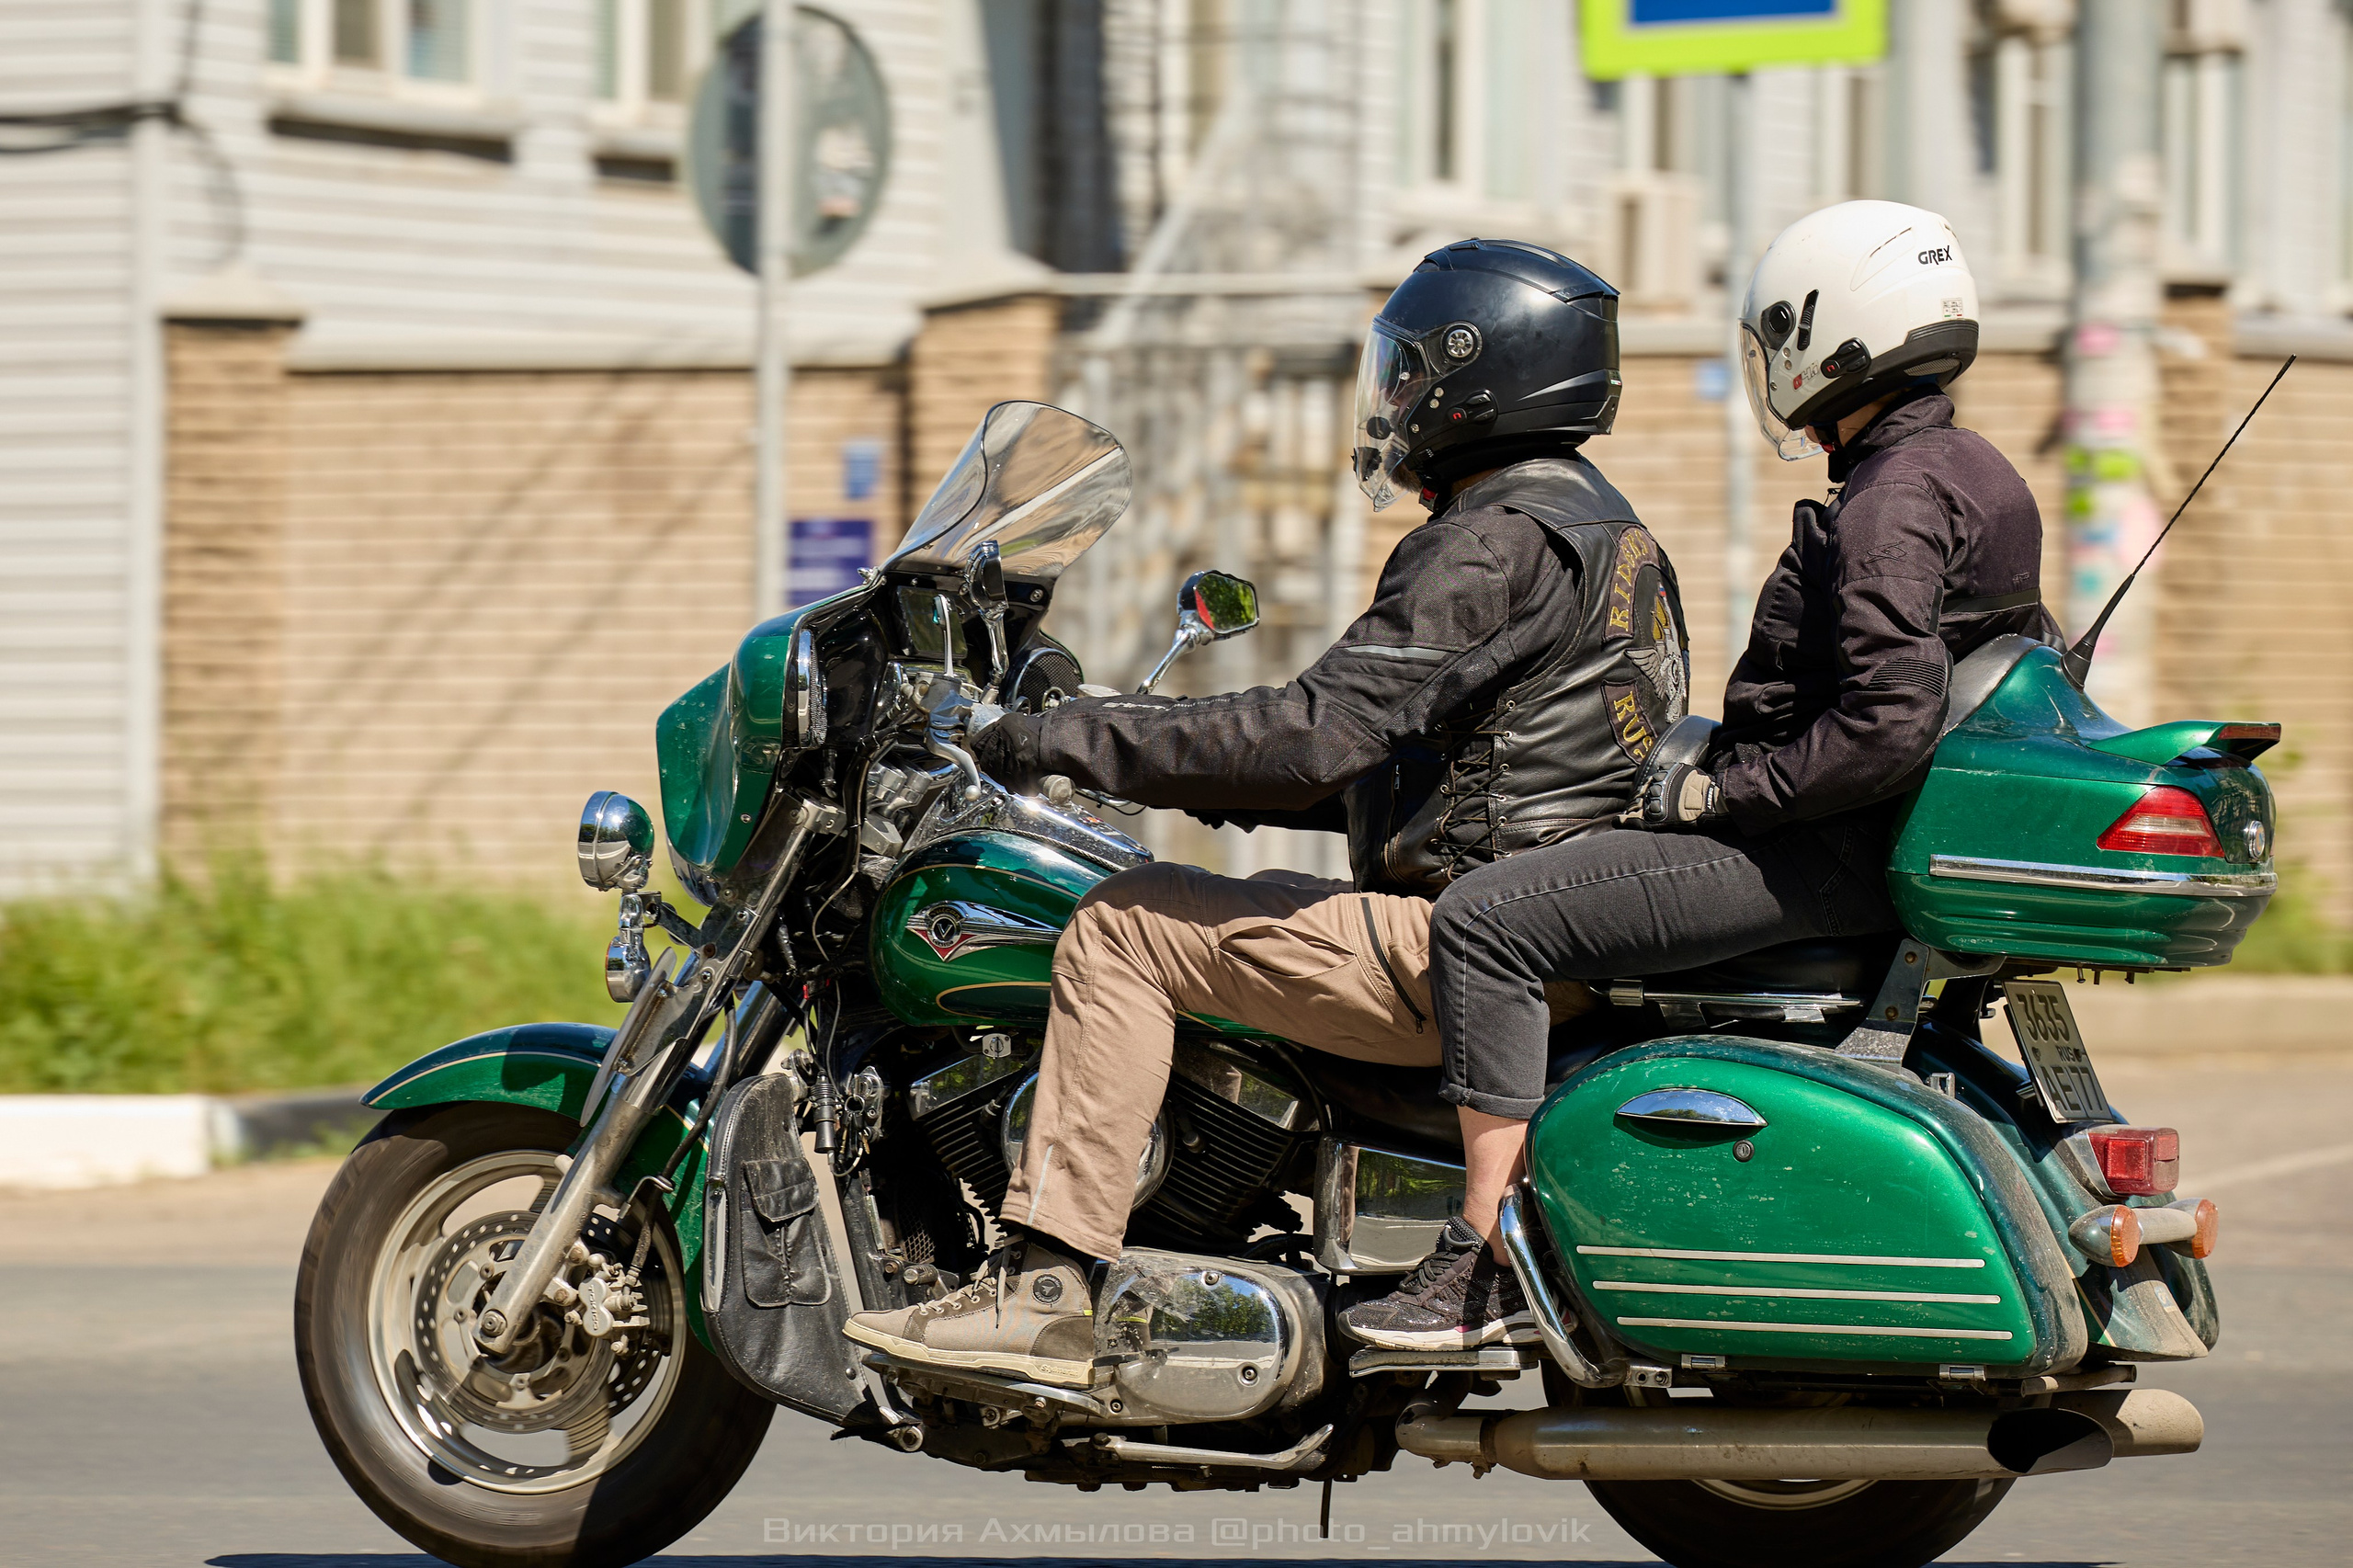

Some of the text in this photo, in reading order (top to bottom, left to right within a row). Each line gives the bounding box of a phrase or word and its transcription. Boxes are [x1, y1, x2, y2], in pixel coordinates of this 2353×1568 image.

[1917, 244, 1953, 266] GREX
[1609, 529, 1648, 631] RIDERS
[2016, 993, 2071, 1043] 3635
[2055, 1045, 2076, 1062] RUS
